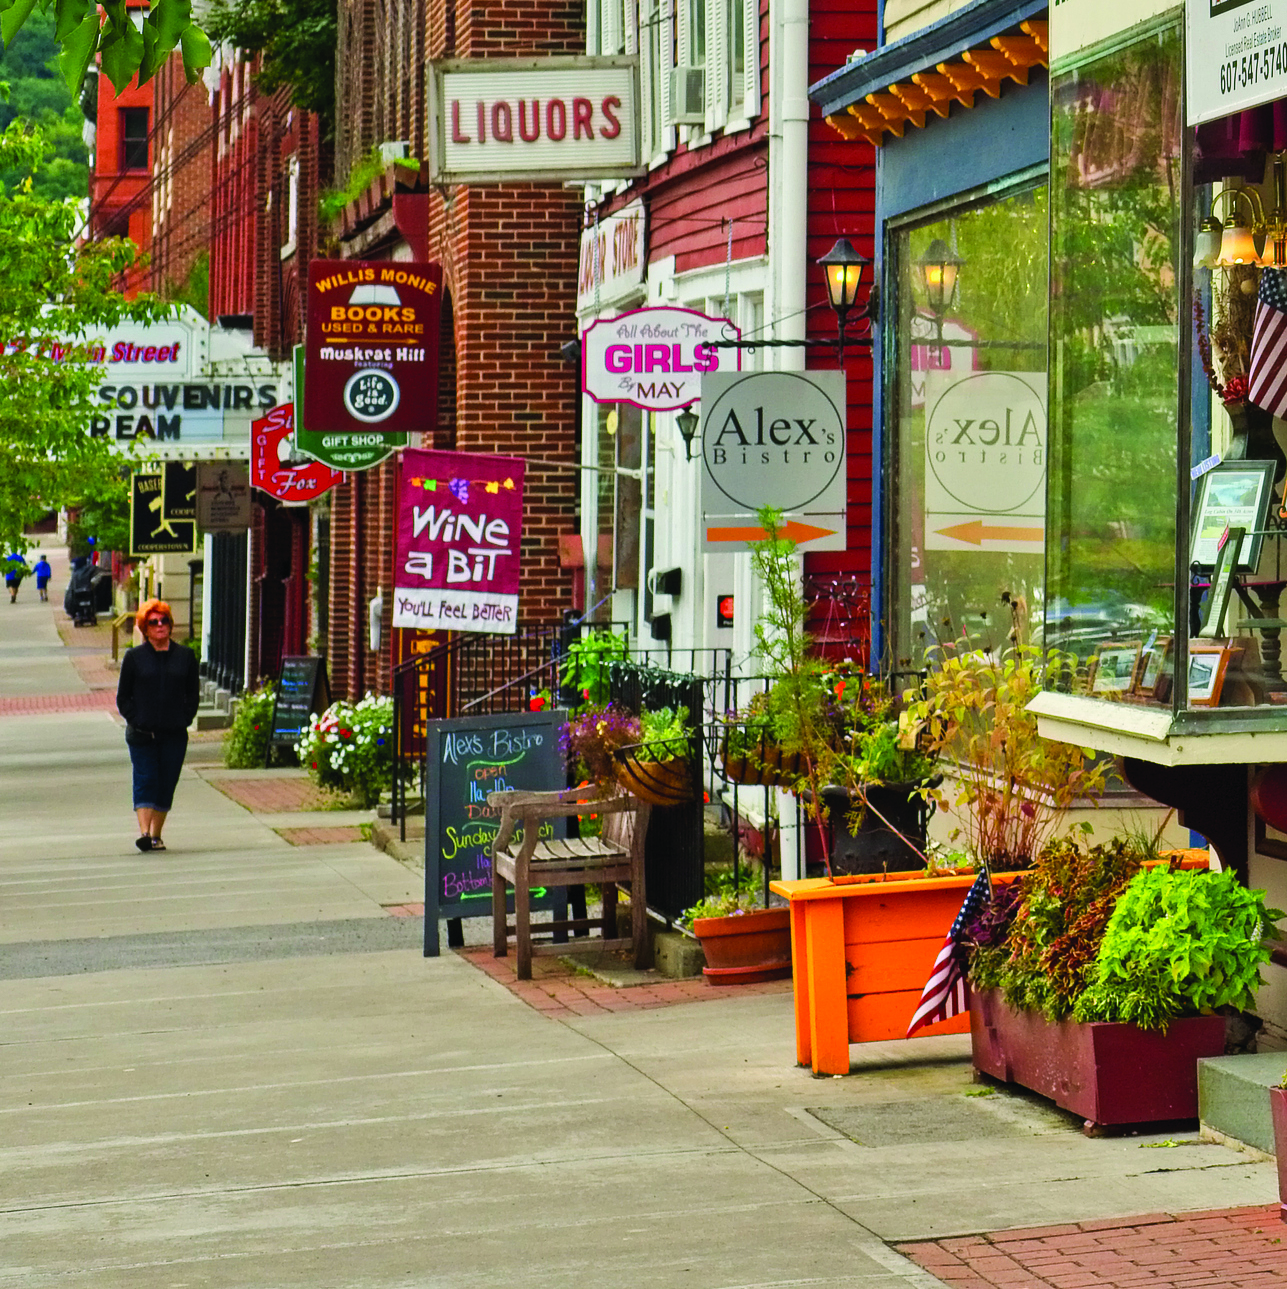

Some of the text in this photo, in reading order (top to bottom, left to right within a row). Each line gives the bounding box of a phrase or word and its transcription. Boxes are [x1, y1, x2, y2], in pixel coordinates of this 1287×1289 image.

[1252, 3, 1273, 26] HUBBELL
[1225, 25, 1282, 58] Licensed Real Estate Broker
[1220, 42, 1287, 95] 607-547-5740
[452, 95, 622, 144] LIQUORS
[315, 268, 437, 295] WILLIS MONIE
[330, 306, 416, 322] BOOKS
[321, 322, 424, 334] USED & RARE
[616, 323, 708, 338] All About The
[111, 341, 181, 363] Street
[319, 346, 426, 362] Muskrat Hill
[605, 344, 720, 374] GIRLS
[359, 376, 384, 391] Life
[637, 382, 686, 399] MAY
[100, 385, 277, 410] SOUVENIRS
[716, 406, 836, 447] Alex's
[322, 434, 384, 447] GIFT SHOP
[256, 434, 267, 481] GIFT
[712, 448, 836, 465] Bistro
[271, 471, 317, 496] Fox
[443, 729, 544, 766] Alex's Bistro
[474, 765, 508, 780] open
